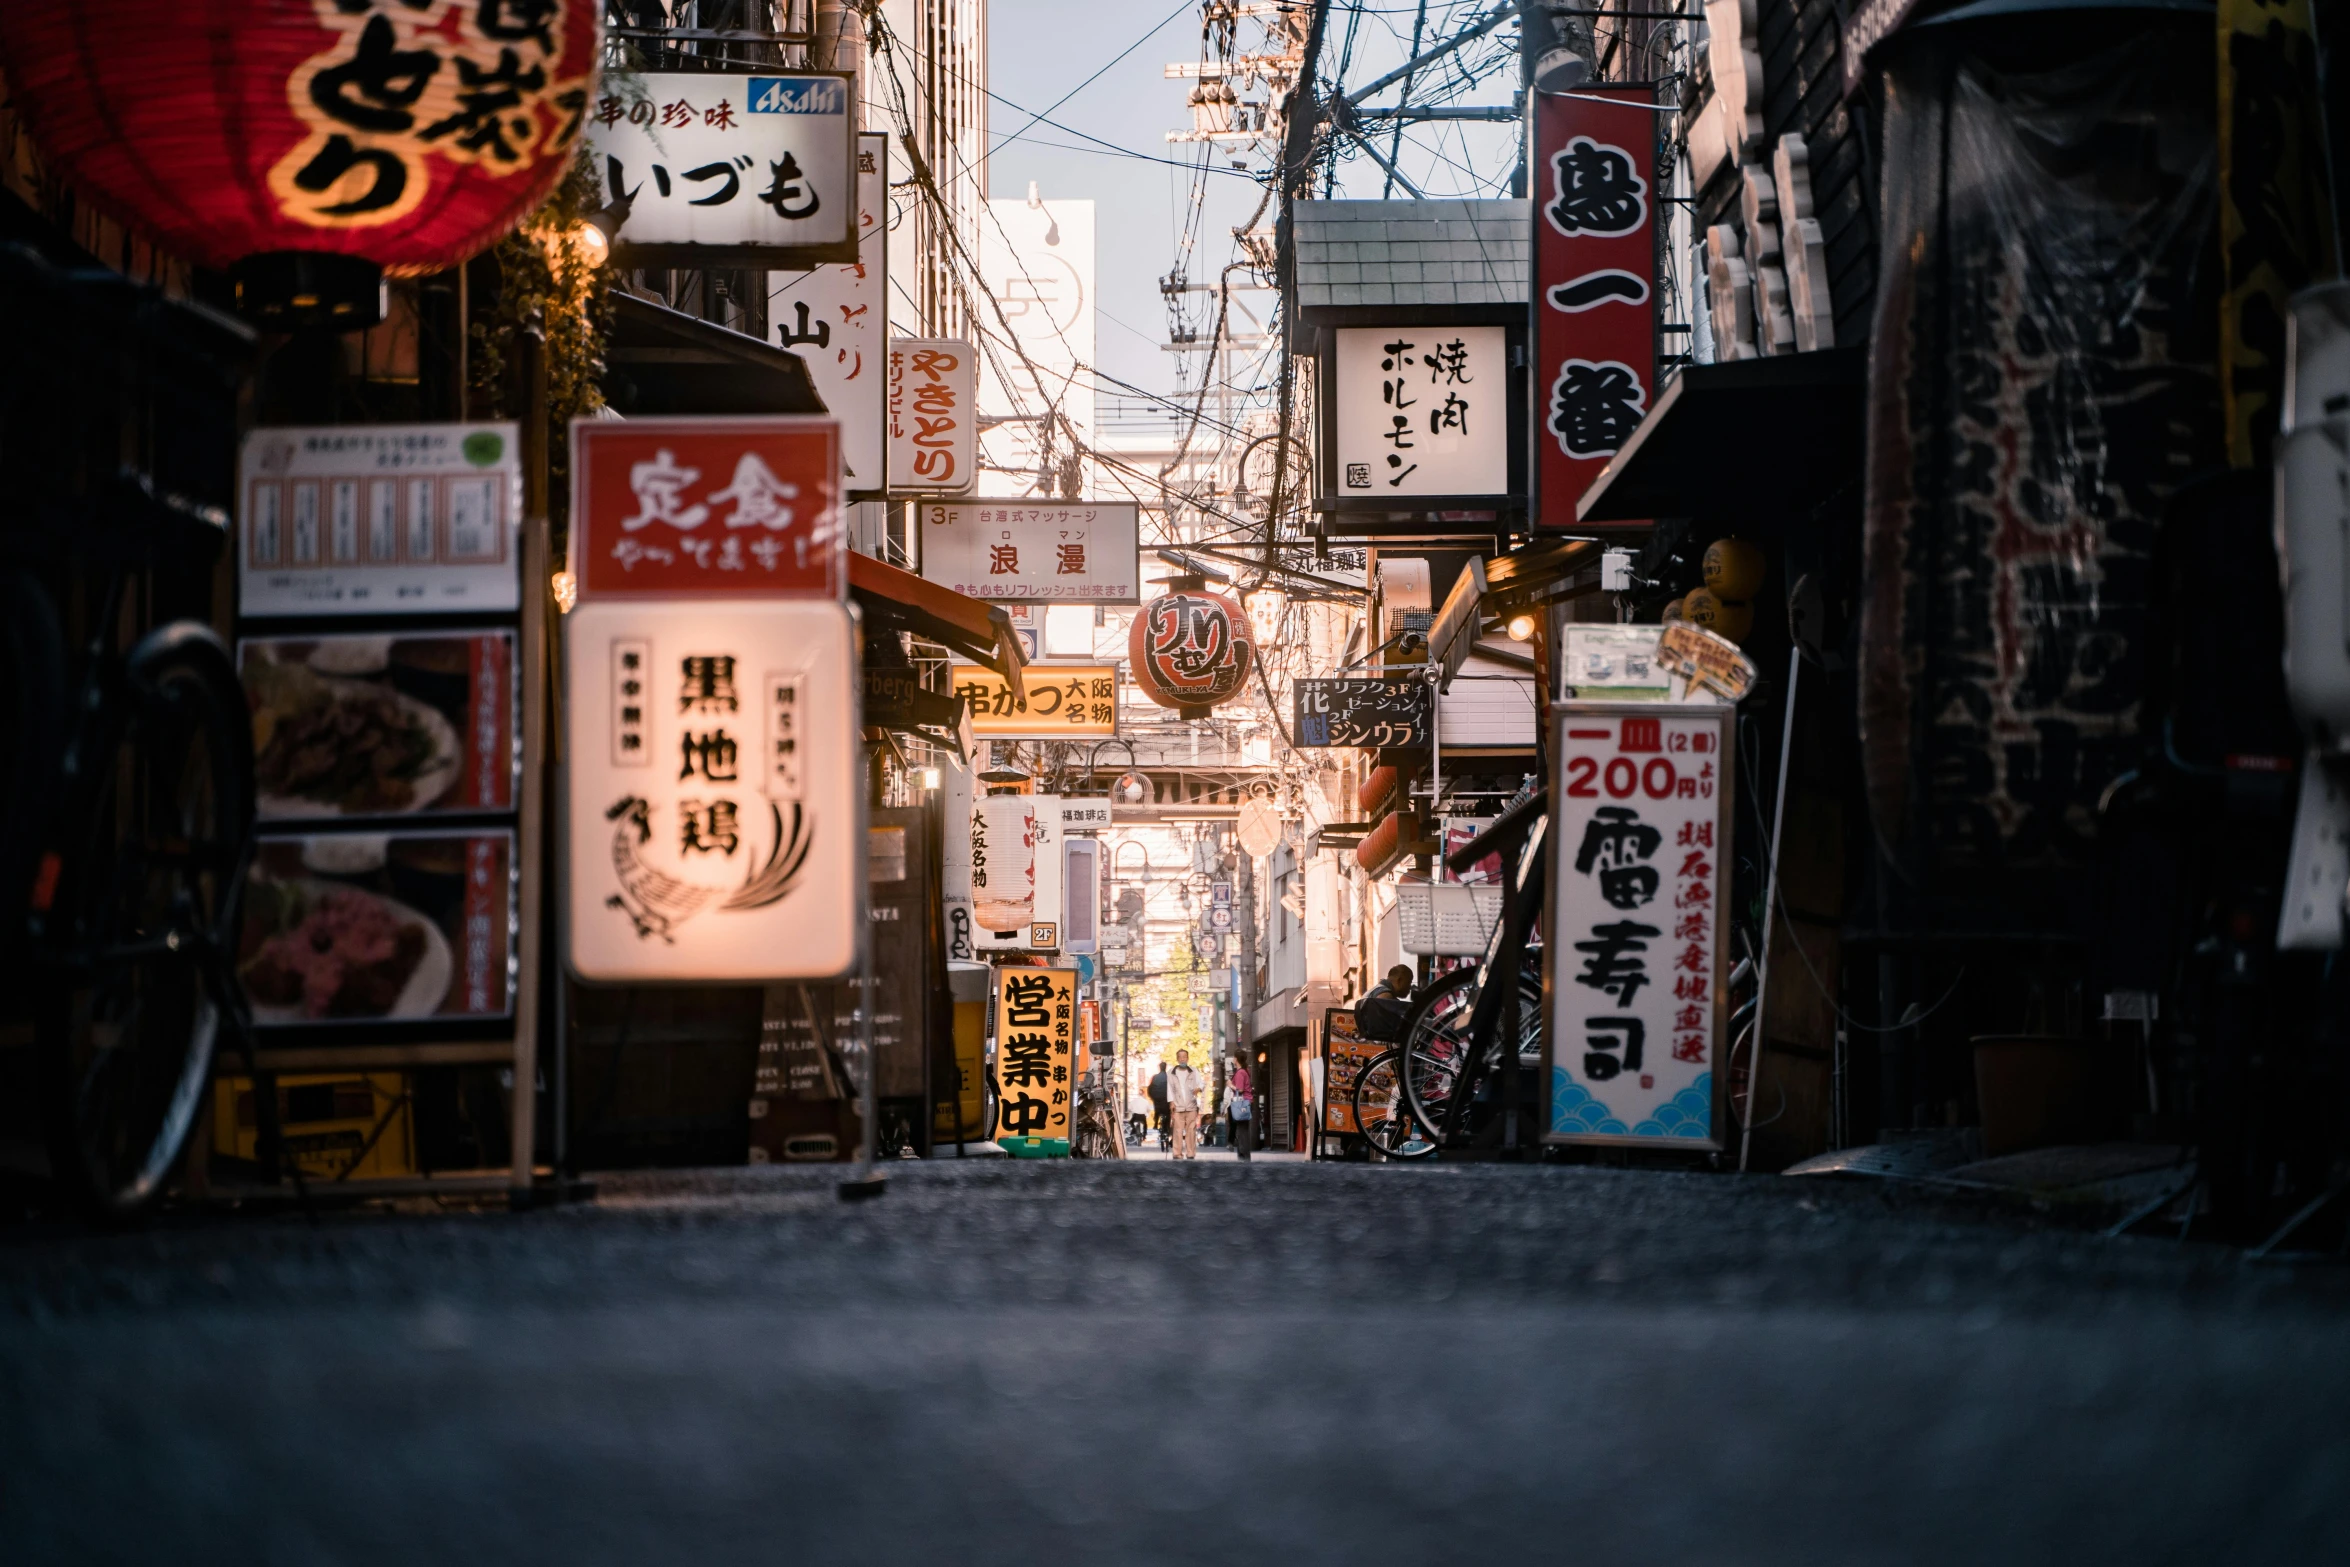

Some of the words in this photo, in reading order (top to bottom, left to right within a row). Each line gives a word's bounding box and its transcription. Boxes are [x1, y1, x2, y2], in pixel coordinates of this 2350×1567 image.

[598, 98, 739, 131] 串の珍味
[755, 82, 838, 114] Asahi
[606, 151, 820, 220] いづも
[1547, 137, 1648, 459] 黒一番
[778, 301, 830, 349] 山
[889, 352, 905, 440] キリンビール
[1424, 338, 1474, 435] 焼肉
[912, 350, 959, 482] やきとり
[1381, 338, 1418, 487] ホルモン
[620, 447, 800, 532] 定食
[931, 507, 958, 524] 3F
[980, 510, 1097, 522] 台湾式マッサージ
[954, 583, 1128, 596] 身も心もリフレッシュ出来ます
[955, 681, 1062, 719] 串かつ
[1065, 678, 1112, 699] 大阪
[1385, 683, 1410, 697] 3F
[1065, 702, 1112, 724] 名物
[1329, 708, 1353, 723] 2F
[1568, 718, 1662, 753] 一皿
[679, 655, 738, 860] 黒地鶏
[1567, 757, 1697, 800] 200円
[1062, 809, 1107, 821] 福珈琲店
[971, 809, 988, 888] 大阪名物
[1034, 928, 1053, 941] 2F
[1574, 806, 1663, 1081] 雷寿司
[1054, 986, 1071, 1055] 大阪名物
[1001, 975, 1054, 1136] 営業中
[1050, 1065, 1068, 1126] 串かつ
